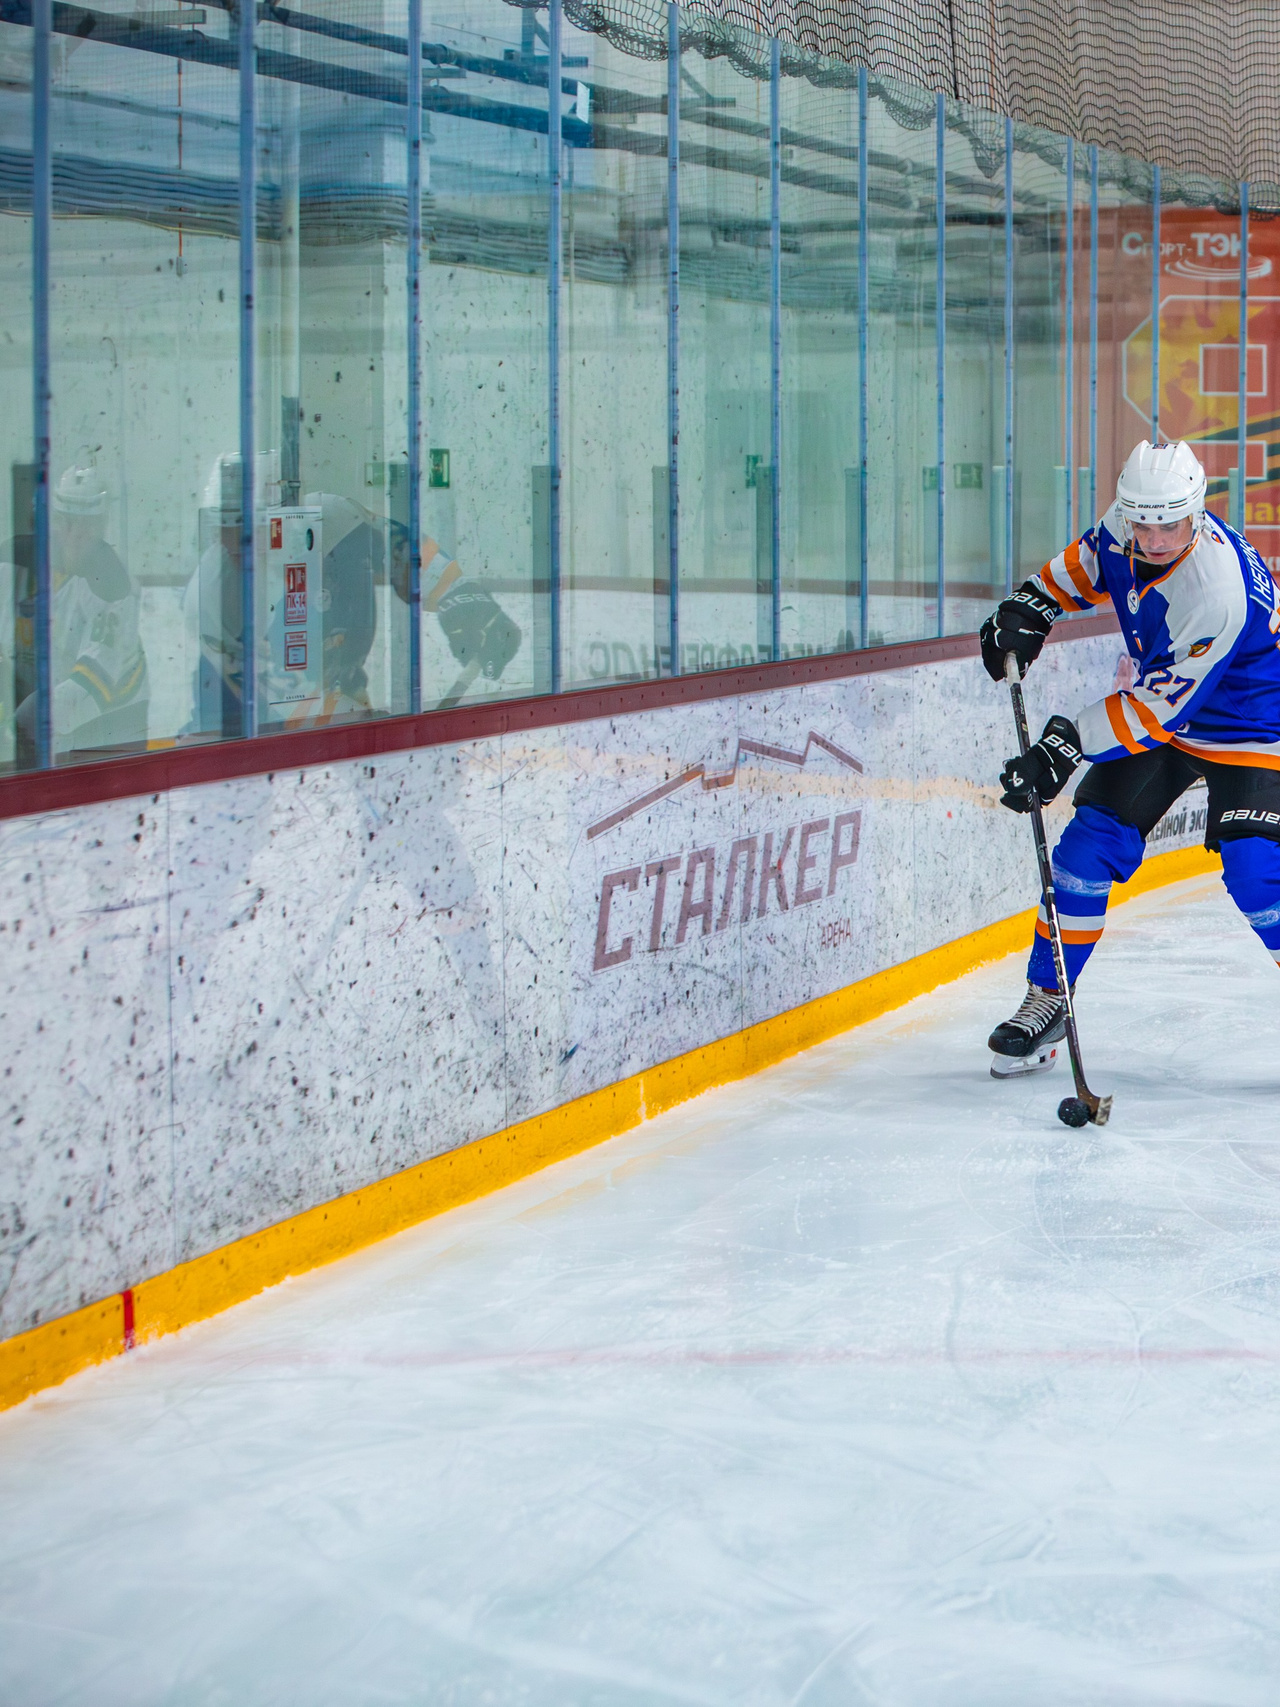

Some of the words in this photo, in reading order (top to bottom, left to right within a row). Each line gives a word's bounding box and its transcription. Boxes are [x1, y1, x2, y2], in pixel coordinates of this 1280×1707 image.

[1145, 668, 1197, 708] 27
[593, 809, 862, 972] СТАЛКЕР
[821, 917, 852, 950] АРЕНА
